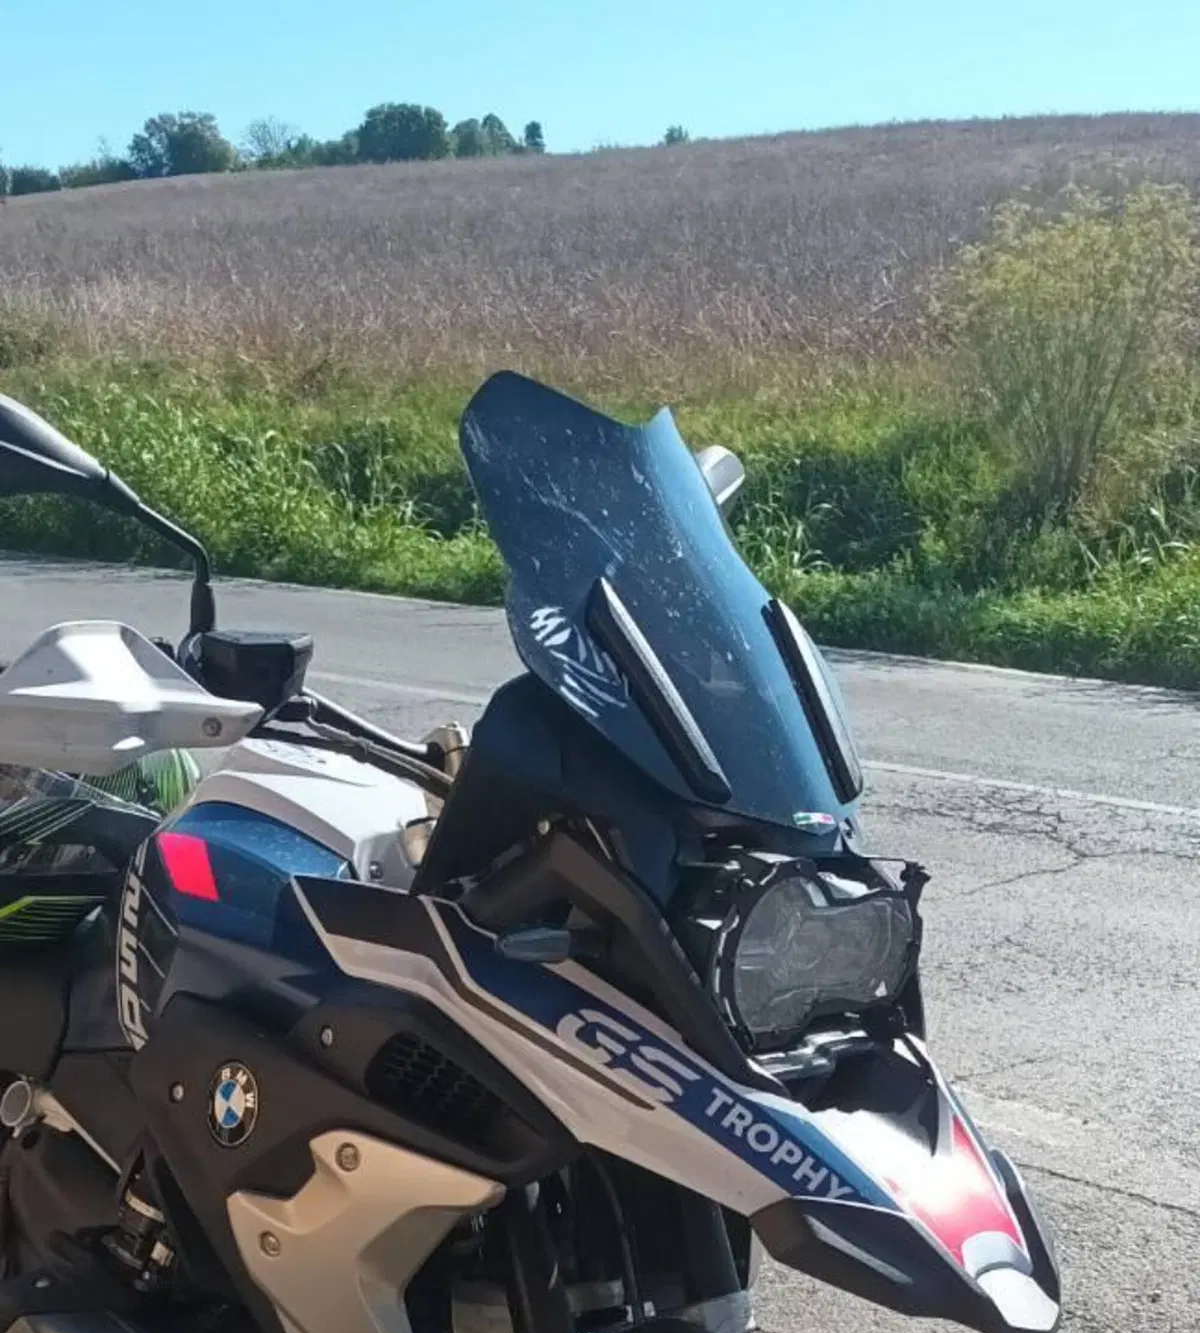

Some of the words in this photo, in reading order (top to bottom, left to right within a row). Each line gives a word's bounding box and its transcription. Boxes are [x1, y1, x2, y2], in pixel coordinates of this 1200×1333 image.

[221, 1067, 255, 1109] BMW
[556, 1008, 702, 1103] GS
[704, 1087, 854, 1200] TROPHY
